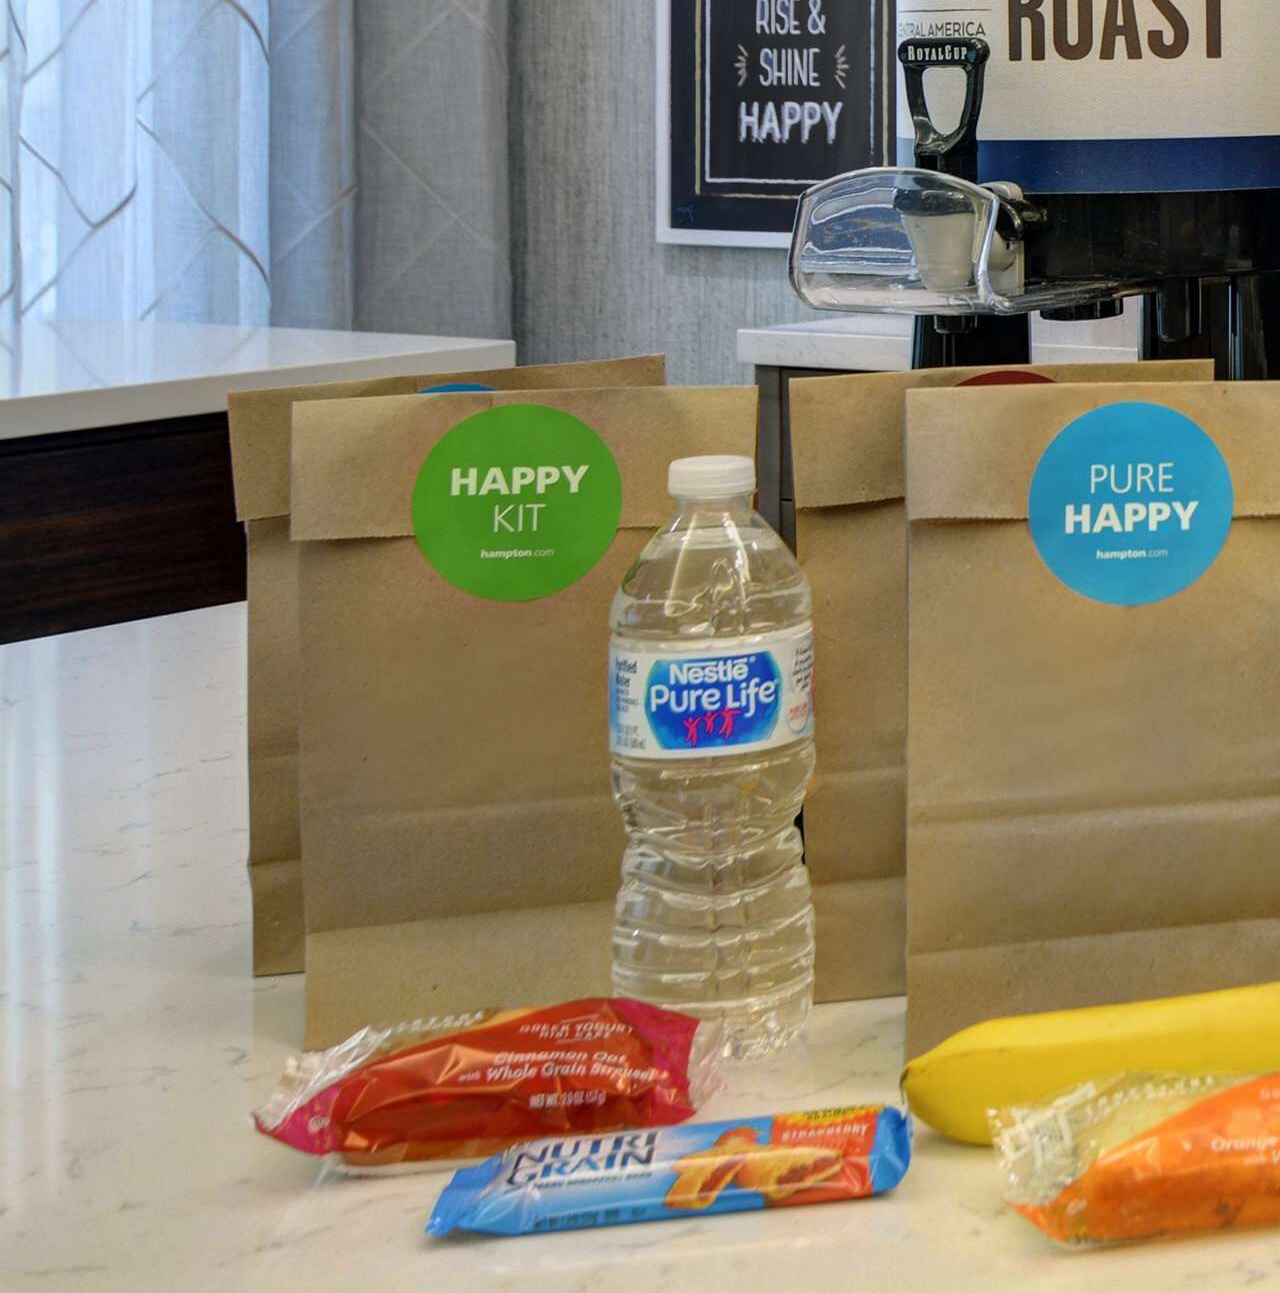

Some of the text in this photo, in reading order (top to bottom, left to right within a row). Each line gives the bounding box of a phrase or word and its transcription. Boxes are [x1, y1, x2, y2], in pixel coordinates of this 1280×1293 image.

[927, 21, 986, 37] AMERICA
[759, 48, 820, 88] SHINE
[738, 101, 843, 144] HAPPY
[450, 465, 589, 496] HAPPY
[1090, 463, 1175, 494] PURE
[493, 504, 546, 533] KIT
[1064, 501, 1199, 534] HAPPY
[650, 685, 721, 713] Pure
[726, 678, 775, 718] Life
[486, 1063, 537, 1082] Whole
[541, 1062, 586, 1078] Grain
[493, 1050, 588, 1065] Cinnamon
[512, 1130, 660, 1171] NUTRI
[1211, 1136, 1278, 1153] Orange
[506, 1148, 656, 1186] GRAIN
